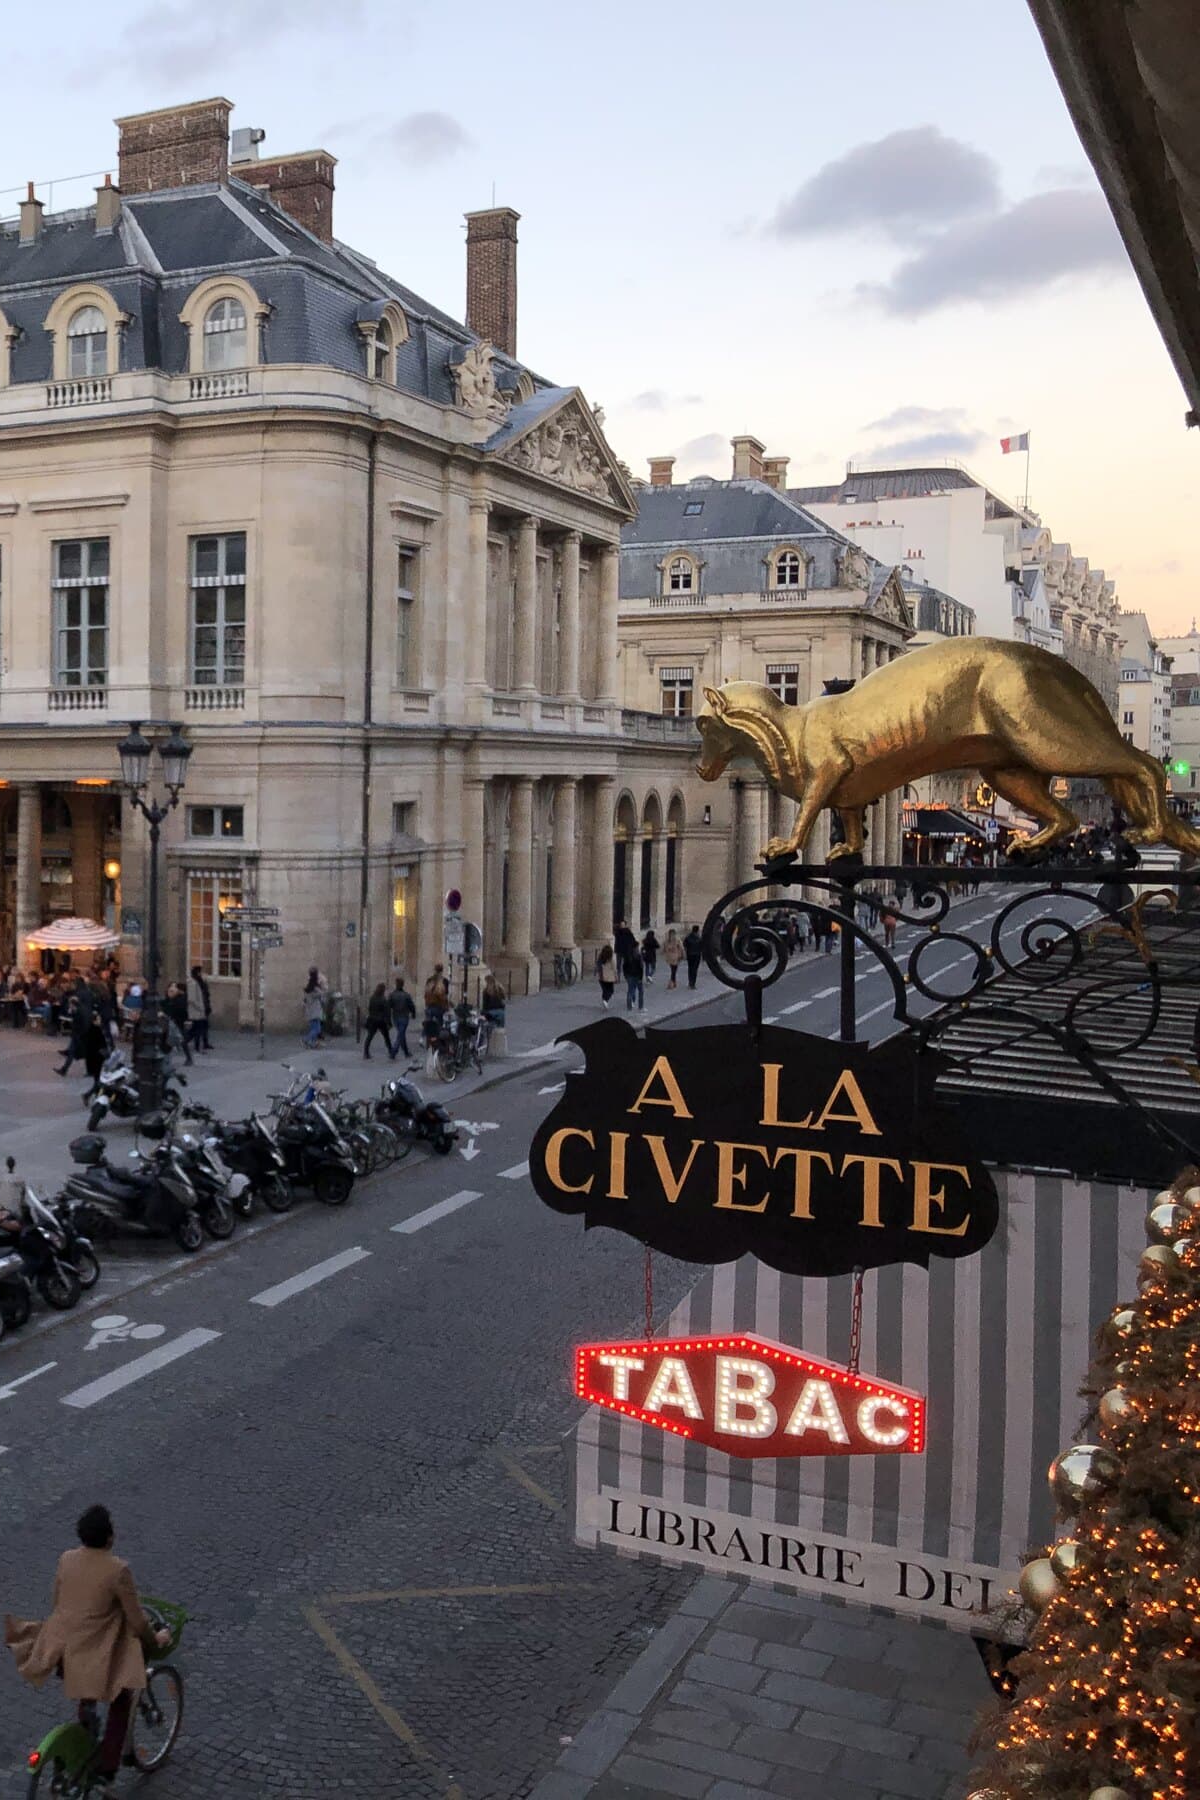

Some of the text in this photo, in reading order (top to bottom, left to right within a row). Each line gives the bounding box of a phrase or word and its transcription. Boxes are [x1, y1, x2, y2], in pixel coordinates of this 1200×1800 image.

[627, 1055, 883, 1136] A LA
[544, 1127, 971, 1237] CIVETTE
[599, 1354, 909, 1446] TABAC
[608, 1499, 866, 1589] LIBRAIRIE
